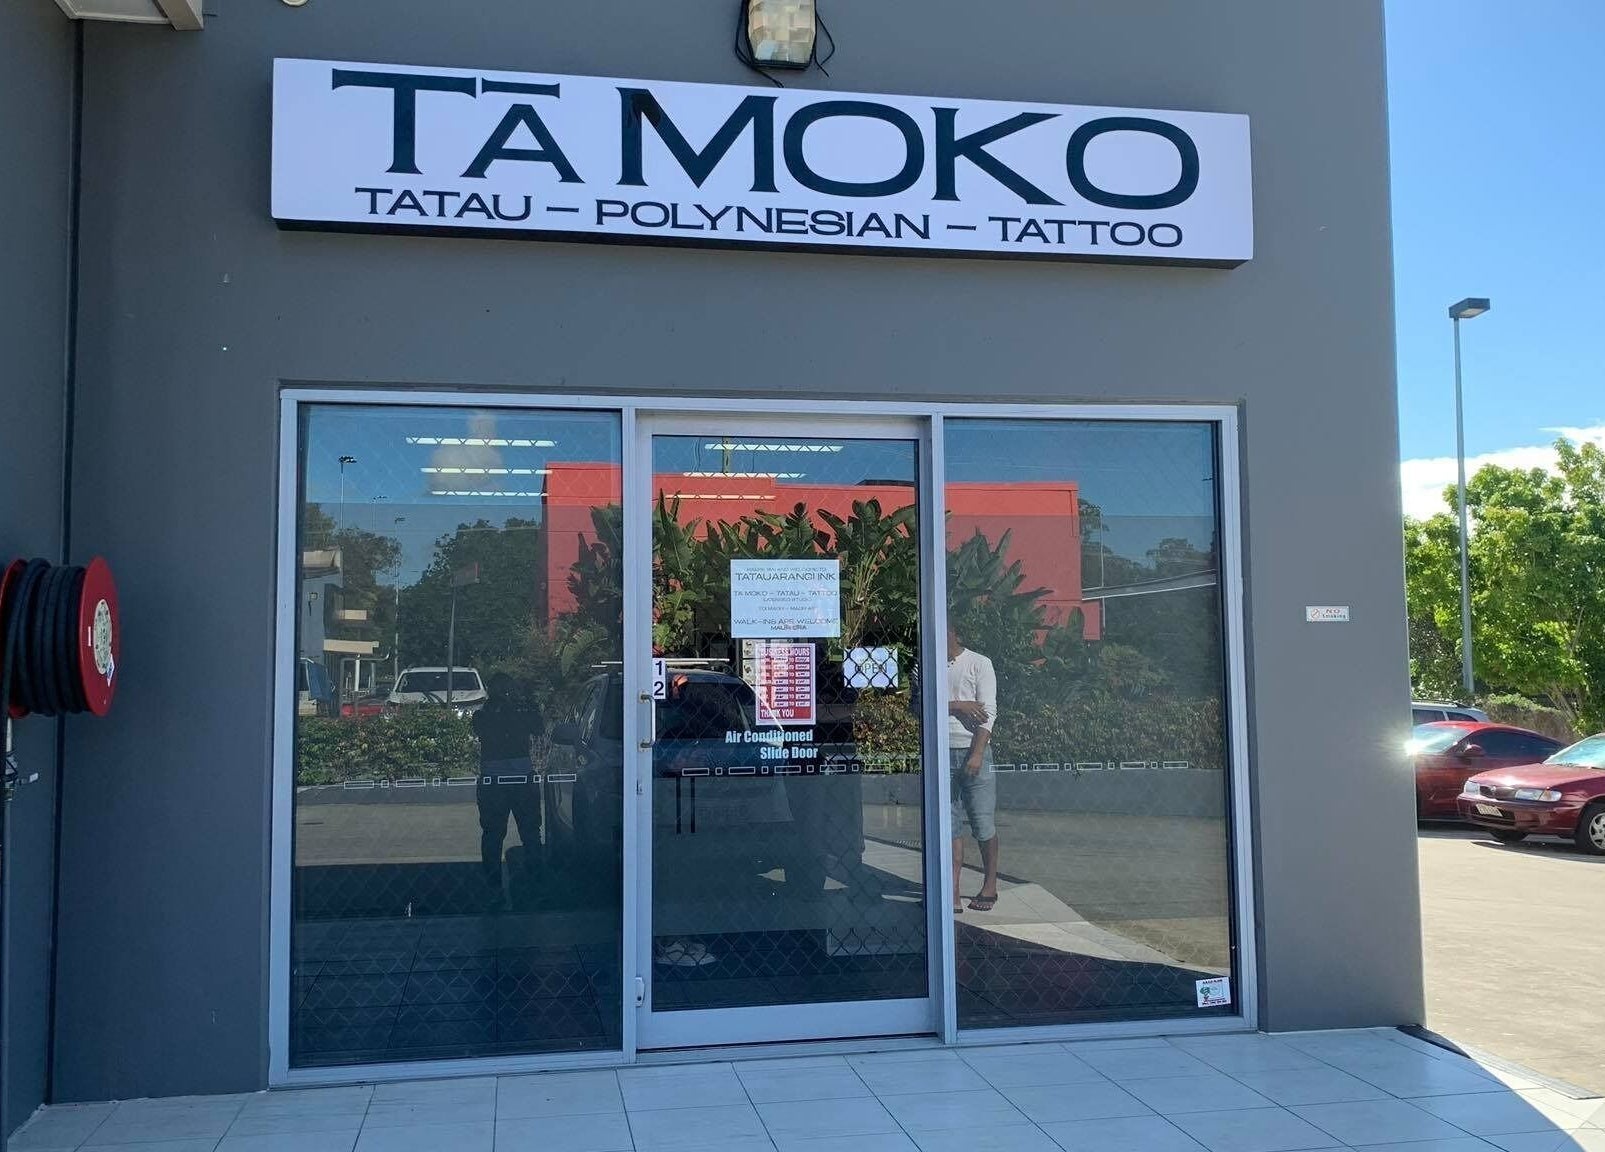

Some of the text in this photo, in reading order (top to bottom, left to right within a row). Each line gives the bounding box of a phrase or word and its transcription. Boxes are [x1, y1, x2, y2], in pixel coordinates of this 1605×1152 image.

[615, 86, 1200, 210] MOKO
[354, 187, 532, 221] TATAU
[595, 199, 931, 240] POLYNESIAN
[988, 216, 1183, 247] TATTOO
[817, 572, 836, 581] INK
[789, 648, 810, 657] HOURS
[855, 662, 888, 673] OPEN
[781, 709, 795, 718] YOU
[724, 729, 814, 743] Air Conditioned
[760, 746, 819, 759] Slide Door
